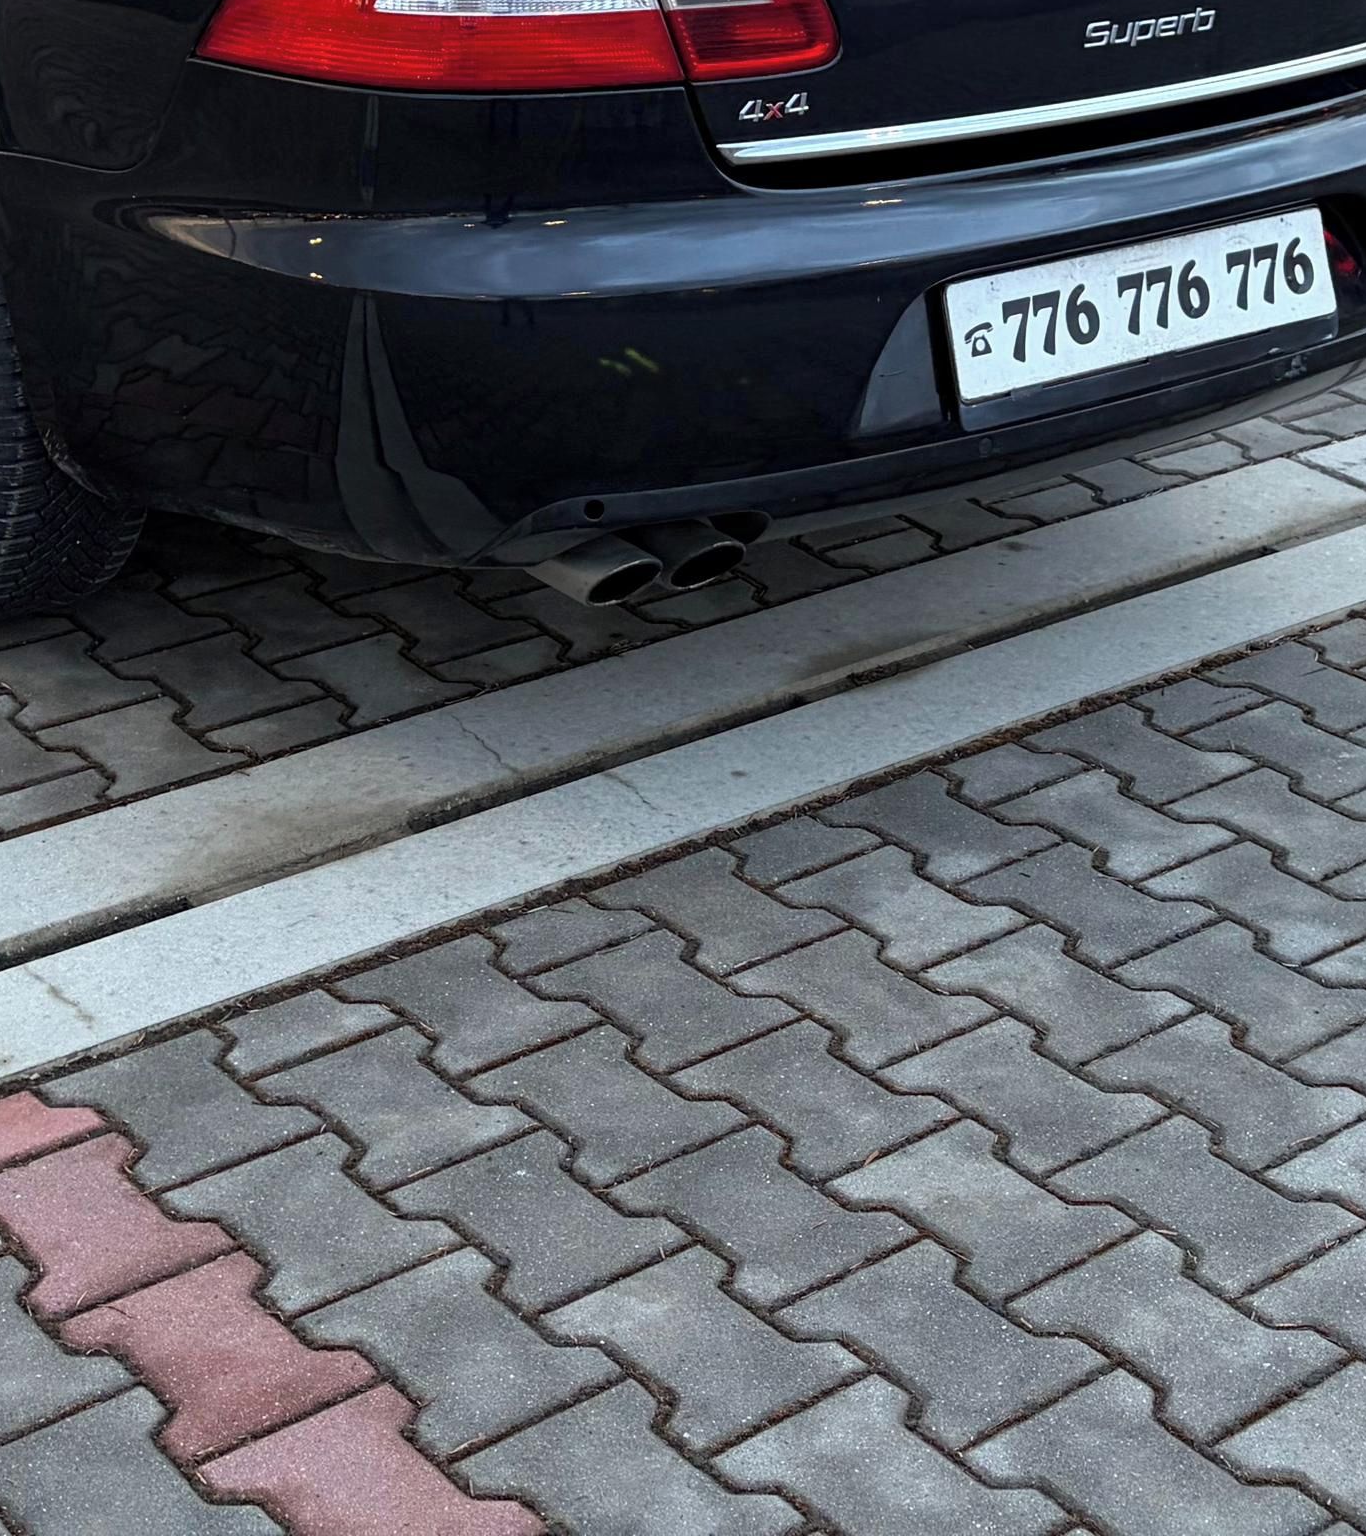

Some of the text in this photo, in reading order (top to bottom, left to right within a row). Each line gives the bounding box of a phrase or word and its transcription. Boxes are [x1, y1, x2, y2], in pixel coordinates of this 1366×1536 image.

[1084, 7, 1216, 48] Superb
[738, 91, 809, 123] 4x4
[1001, 236, 1315, 363] 776 776 776
